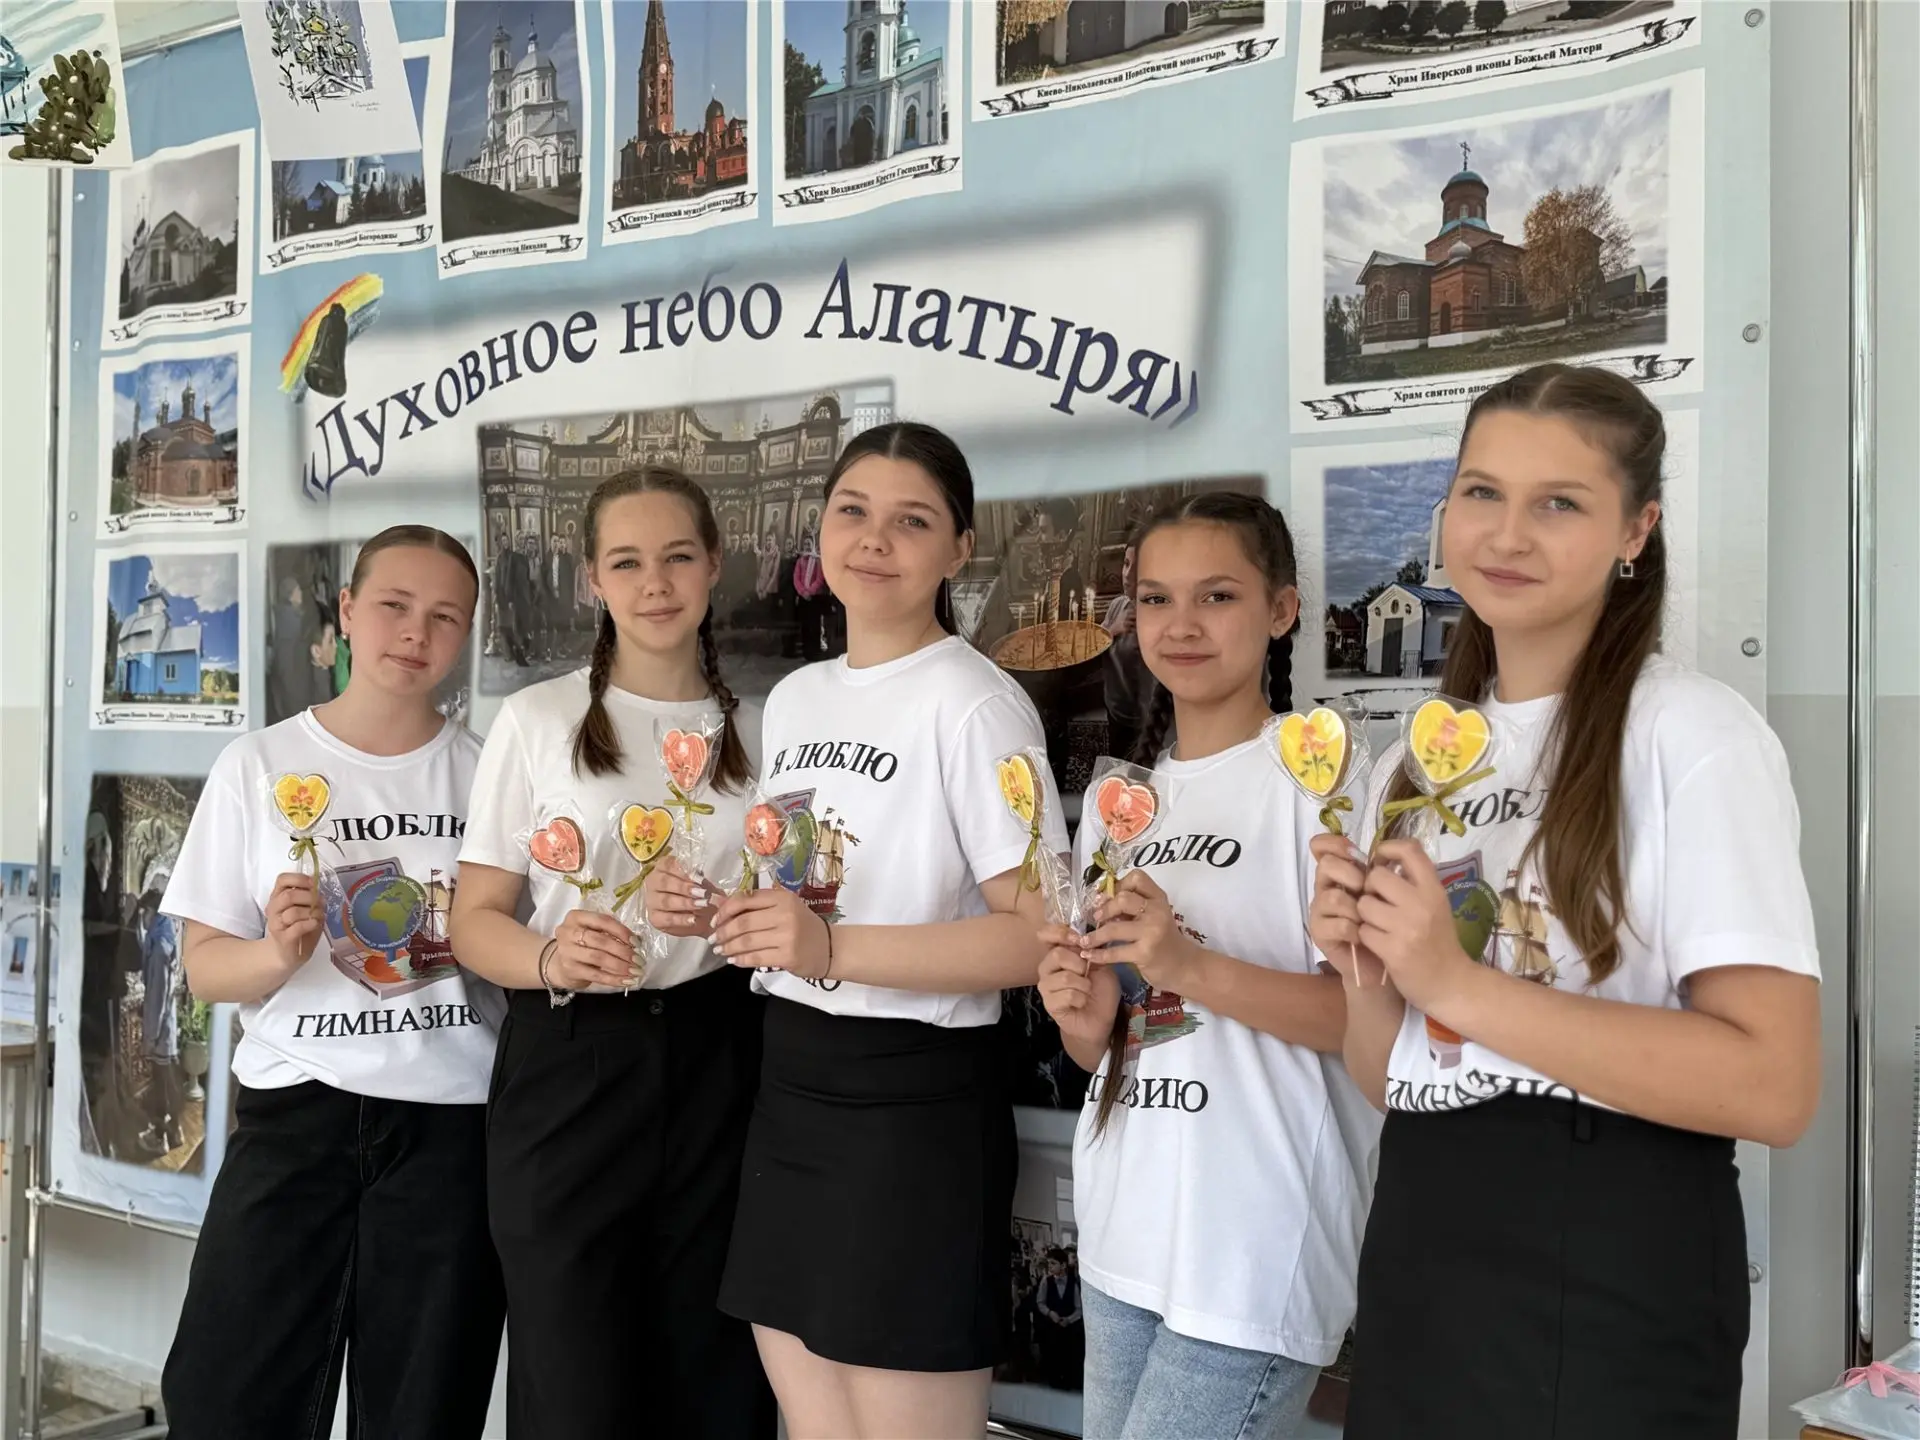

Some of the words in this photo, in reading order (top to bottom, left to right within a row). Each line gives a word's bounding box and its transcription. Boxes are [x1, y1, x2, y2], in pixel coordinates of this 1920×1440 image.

[1036, 74, 1123, 98] Киево-Николаевский
[1180, 50, 1227, 68] монастырь
[1387, 73, 1418, 86] Храм
[1420, 64, 1473, 82] Иверской
[1475, 57, 1511, 73] иконы
[1513, 49, 1556, 65] Божьей
[1558, 42, 1603, 60] Матери
[808, 188, 829, 200] Храм
[302, 310, 598, 503] «Духовное
[619, 262, 783, 354] небо
[804, 257, 1199, 429] Алатыря»
[1393, 388, 1423, 403] Храм
[1424, 385, 1466, 400] святого
[1468, 382, 1494, 395] апос
[769, 749, 788, 779] Я
[786, 741, 898, 783] ЛЮБЛЮ
[293, 1004, 482, 1038] ГИМНАЗИЮ
